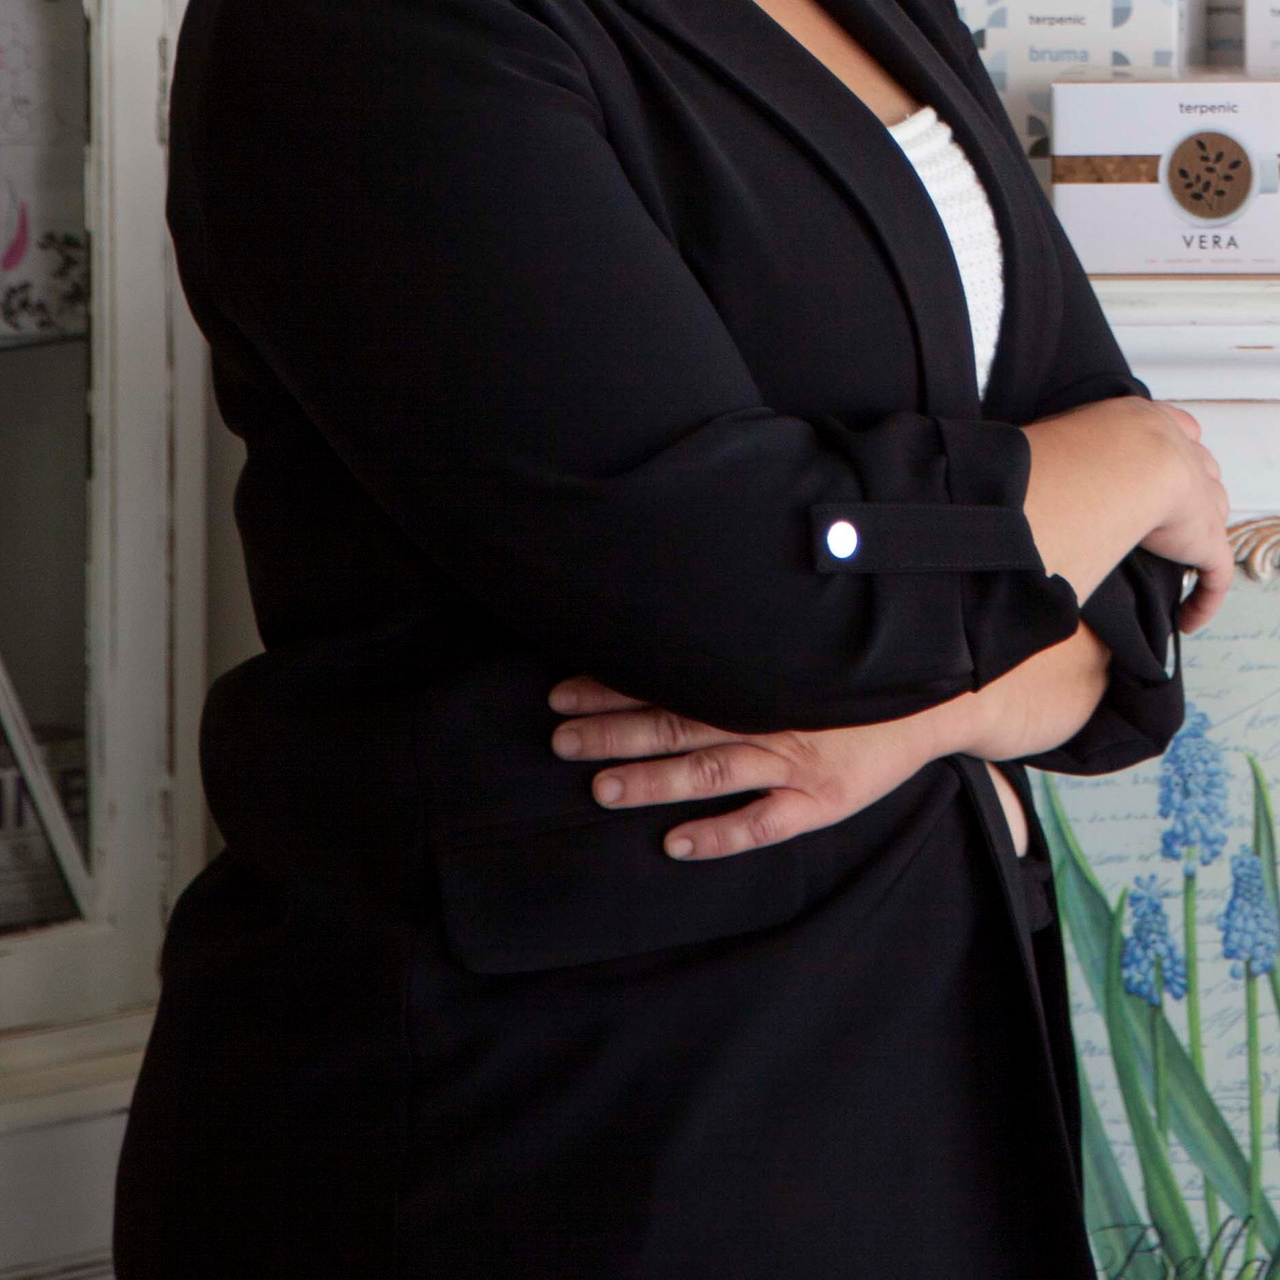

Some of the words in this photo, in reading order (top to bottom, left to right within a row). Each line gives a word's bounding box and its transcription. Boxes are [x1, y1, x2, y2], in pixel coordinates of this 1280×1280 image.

[1028, 13, 1087, 27] terpenic
[1028, 44, 1089, 63] bruma
[1178, 100, 1239, 117] terpenic
[1182, 234, 1240, 250] VERA
